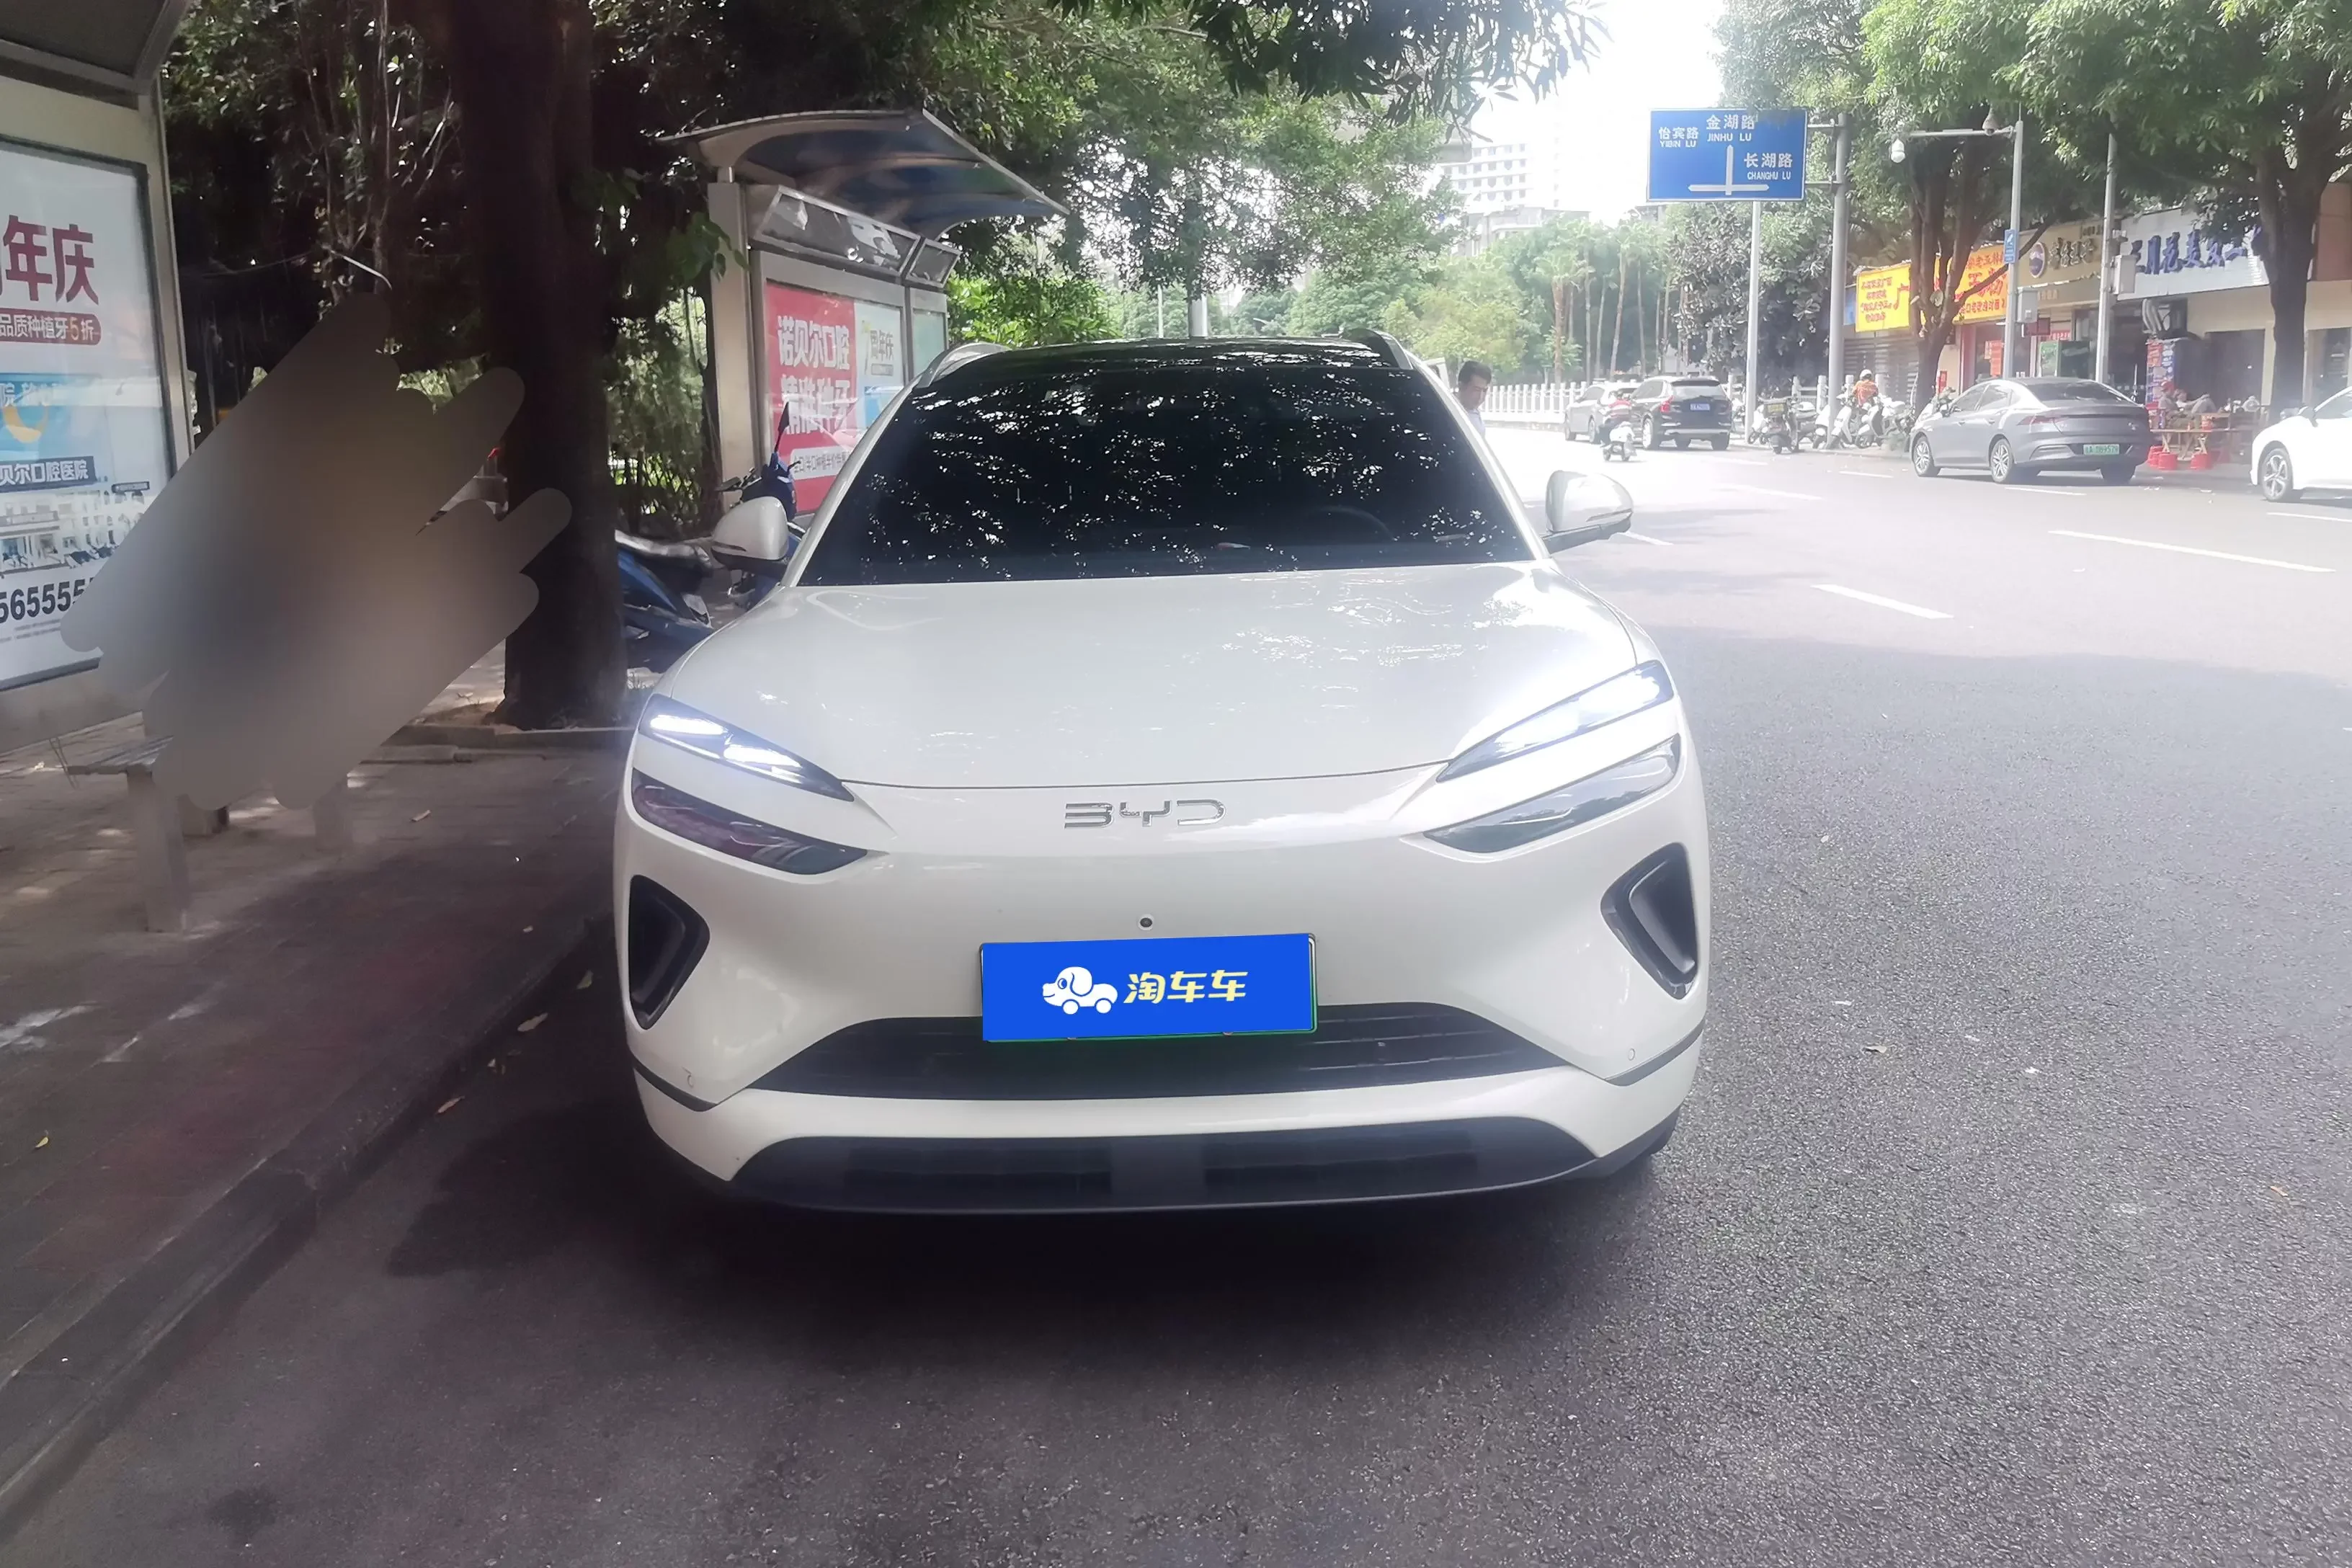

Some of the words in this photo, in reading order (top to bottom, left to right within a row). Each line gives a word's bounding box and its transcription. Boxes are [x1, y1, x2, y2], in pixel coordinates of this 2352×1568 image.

[1659, 126, 1699, 140] 怡宾路
[1706, 114, 1755, 130] 金湖路
[1707, 133, 1733, 142] JINHU
[1740, 133, 1752, 142] LU
[1744, 152, 1793, 168] 长湖路
[1747, 171, 1778, 180] CHANGHU
[1782, 171, 1791, 180] LU
[0, 214, 99, 306] 年庆
[0, 313, 94, 341] 品质种植牙5折
[778, 315, 850, 370] 诺贝尔口腔
[0, 459, 89, 486] 贝尔口腔医院
[0, 577, 94, 624] 565555
[1064, 798, 1226, 829] BYD
